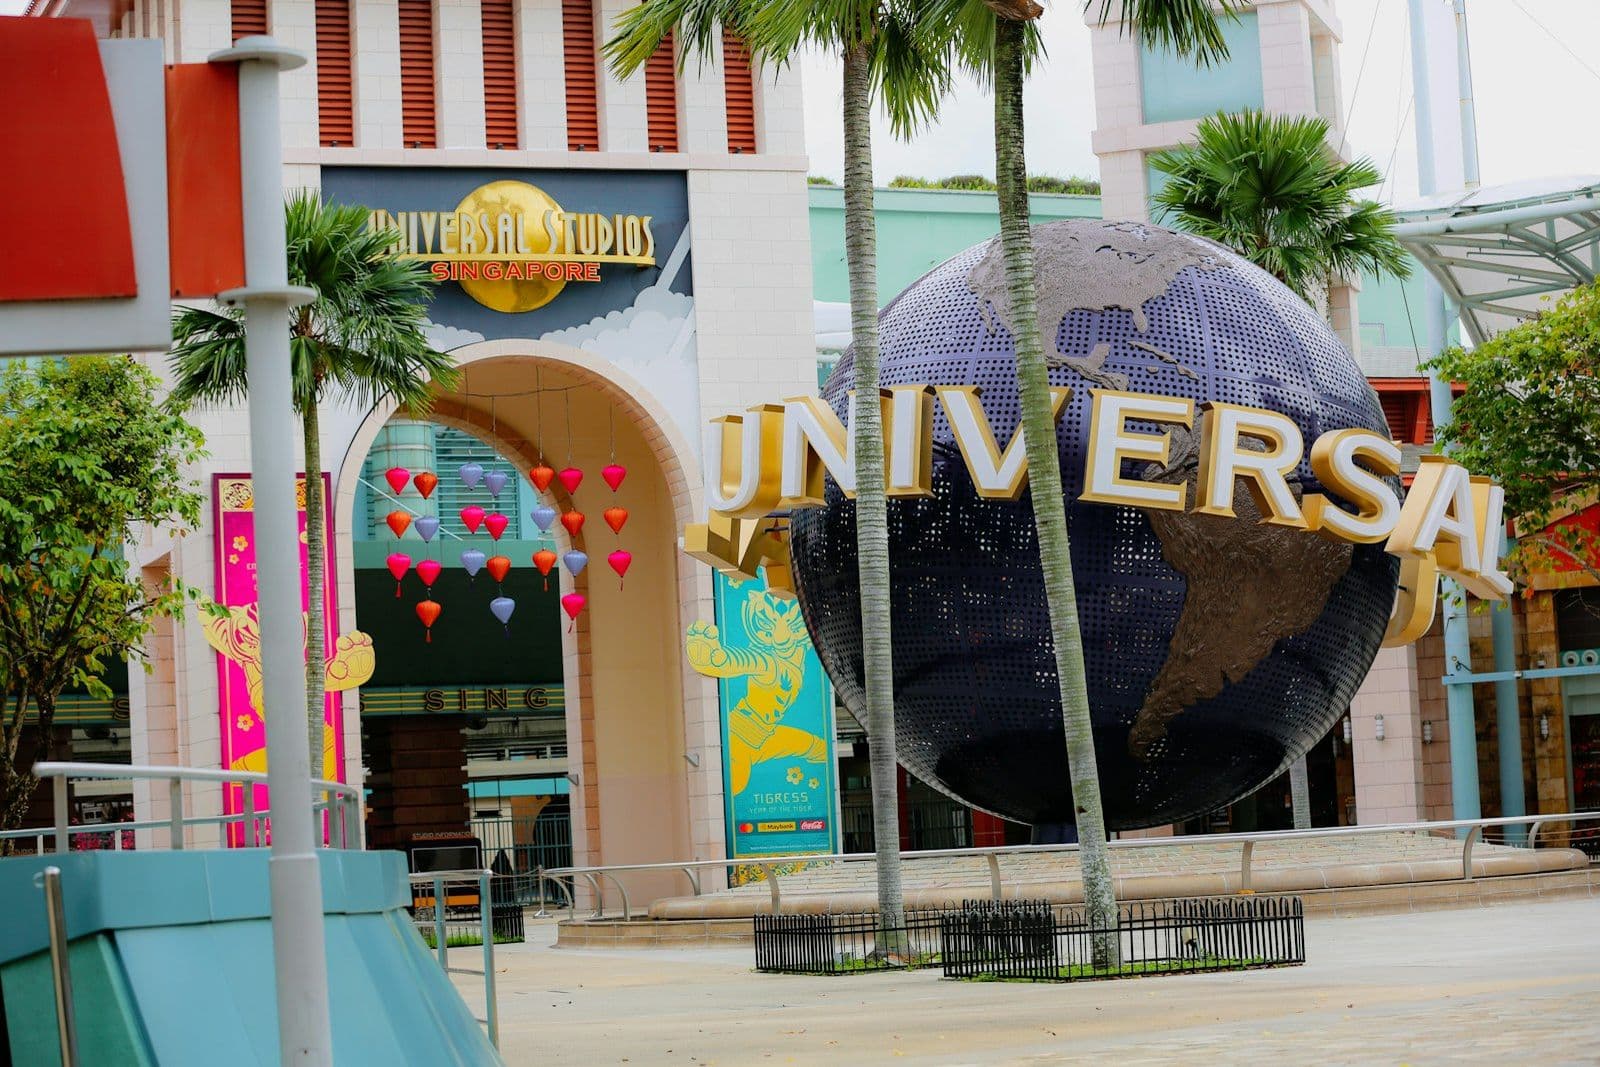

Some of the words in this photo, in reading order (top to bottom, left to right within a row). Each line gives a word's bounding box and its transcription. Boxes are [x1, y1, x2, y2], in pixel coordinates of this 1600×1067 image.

[542, 210, 655, 257] STUDIOS
[431, 261, 601, 282] SINGAPORE
[703, 384, 1514, 600] UNIVERSAL
[425, 687, 549, 711] SING
[753, 792, 808, 803] TIGRESS
[767, 823, 793, 831] Maybank
